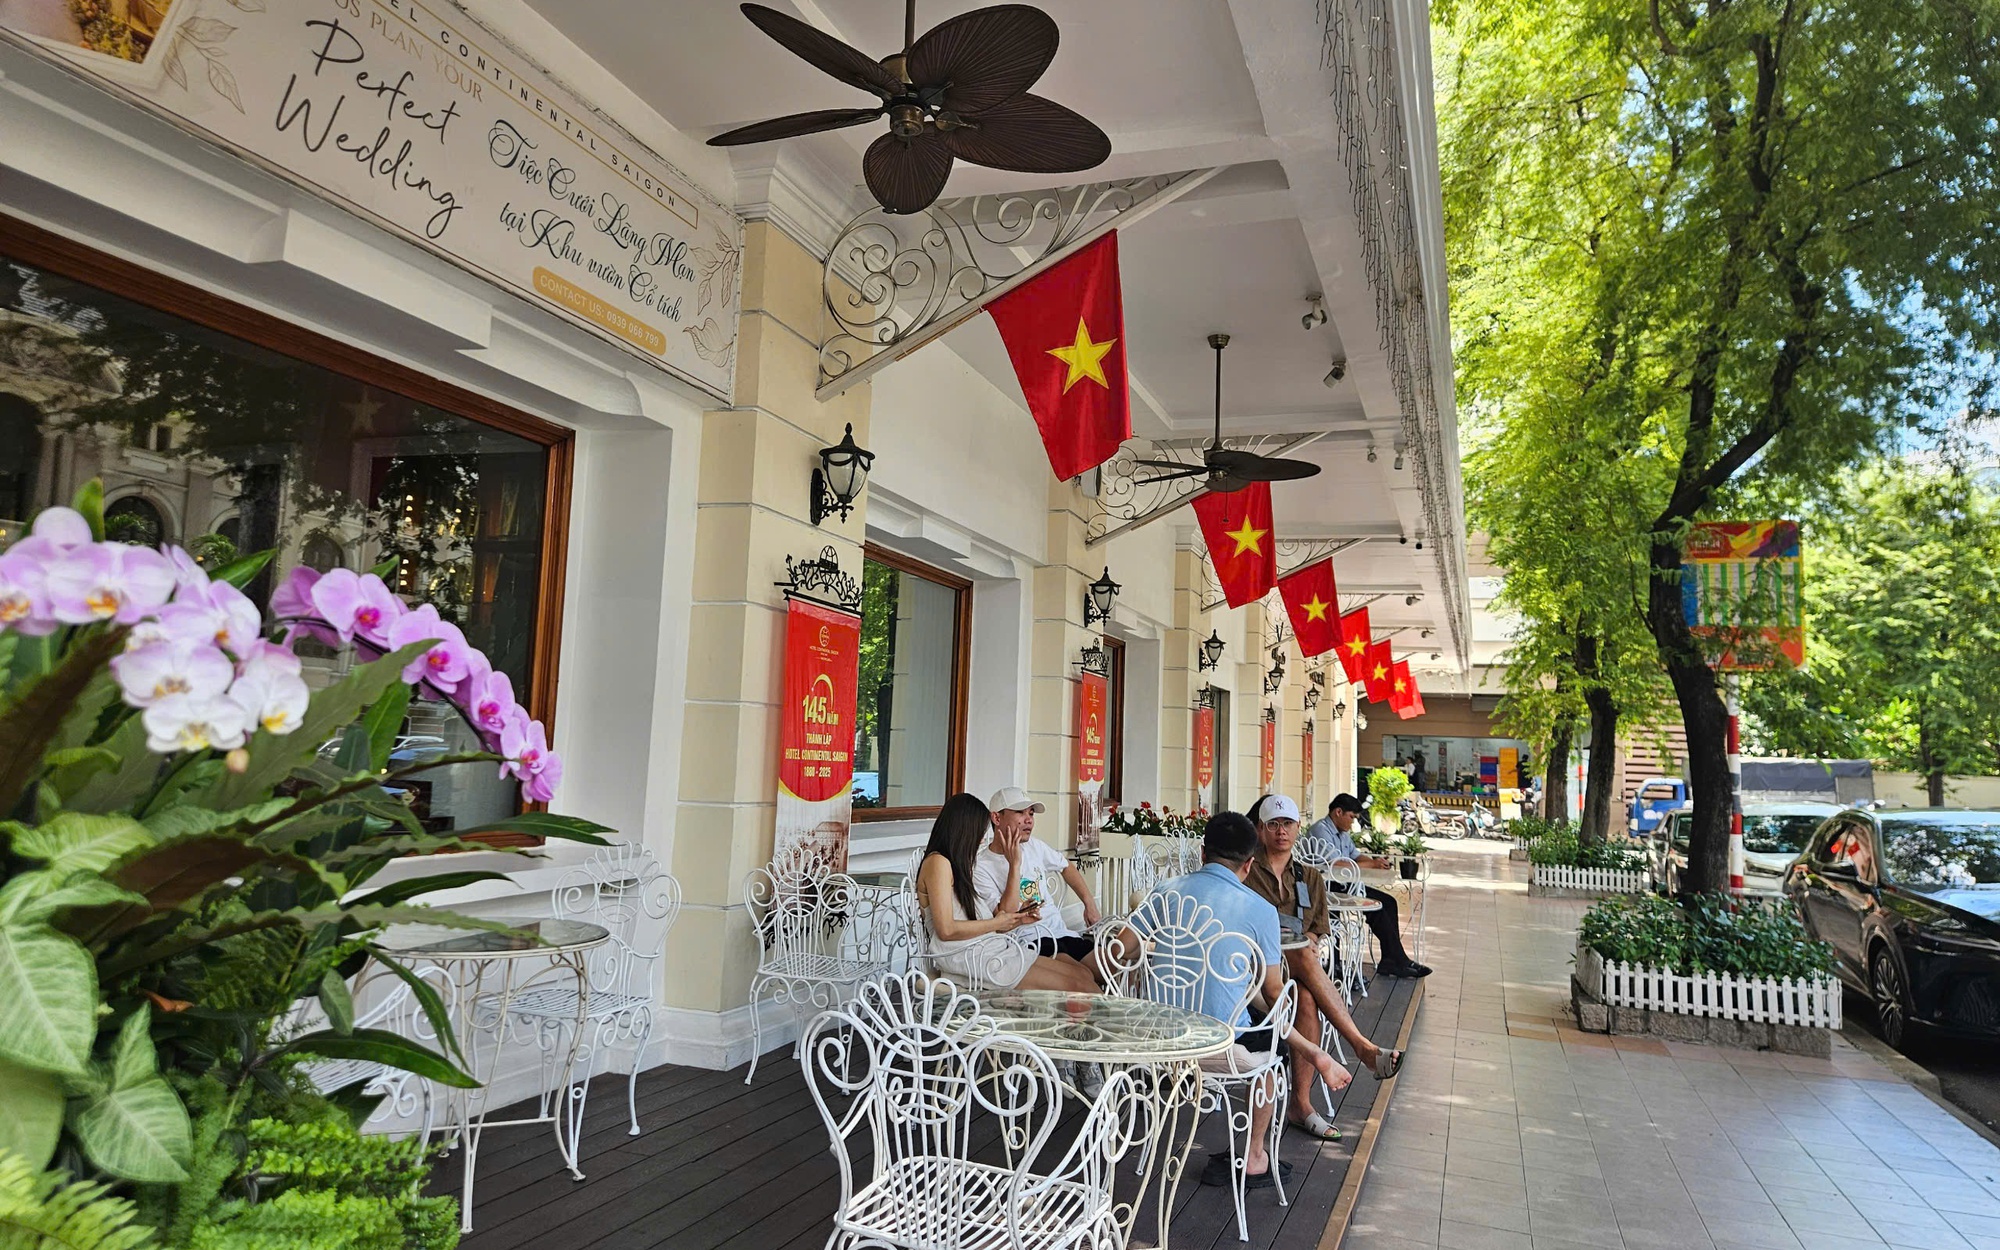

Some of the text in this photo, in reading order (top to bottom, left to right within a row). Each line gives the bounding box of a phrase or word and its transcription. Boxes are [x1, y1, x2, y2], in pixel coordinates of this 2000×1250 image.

[305, 18, 461, 145] Perfect
[371, 11, 424, 61] PLAN
[432, 52, 483, 103] YOUR
[276, 74, 463, 239] Wedding
[441, 31, 597, 150] CONTINENTAL
[611, 153, 675, 207] SAIGON
[488, 119, 696, 283] Tiệc Cưới Lãng Mạn
[499, 202, 683, 323] tại Khu vườn Cổ tích
[540, 274, 659, 347] CONTACT US: 0939 066 799
[785, 748, 800, 760] HOTEL
[802, 695, 827, 724] 145
